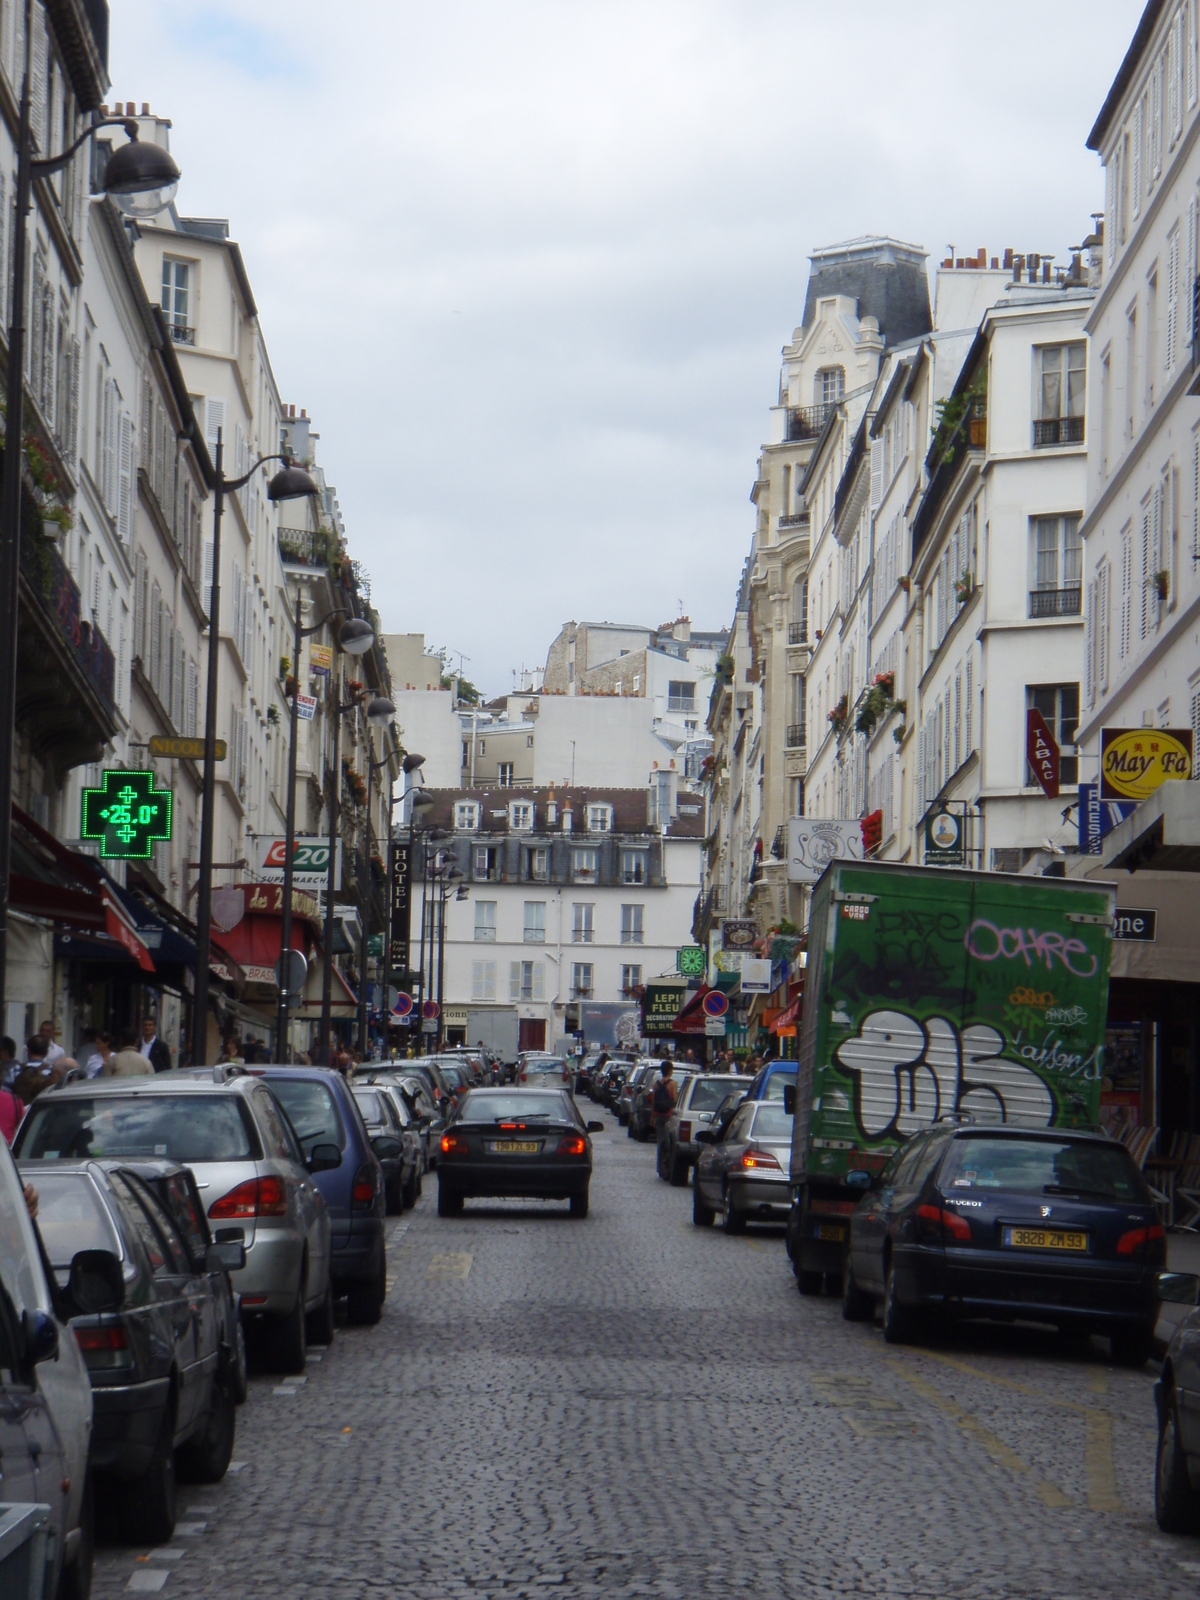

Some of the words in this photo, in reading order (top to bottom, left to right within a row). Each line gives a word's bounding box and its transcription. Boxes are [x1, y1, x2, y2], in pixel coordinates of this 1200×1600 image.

[152, 739, 222, 757] NICOLS
[1033, 728, 1053, 780] TABAC
[1105, 749, 1155, 783] May
[1161, 751, 1188, 773] Fa
[811, 822, 843, 834] CHOCOLAT
[260, 875, 331, 885] SUPEMARCH
[394, 849, 407, 909] HOTEL
[844, 905, 869, 914] CARGO
[849, 912, 864, 920] VAN
[526, 1144, 536, 1152] 93
[1015, 1230, 1045, 1246] 3828
[1049, 1232, 1065, 1247] ZM
[1067, 1233, 1083, 1248] 93
